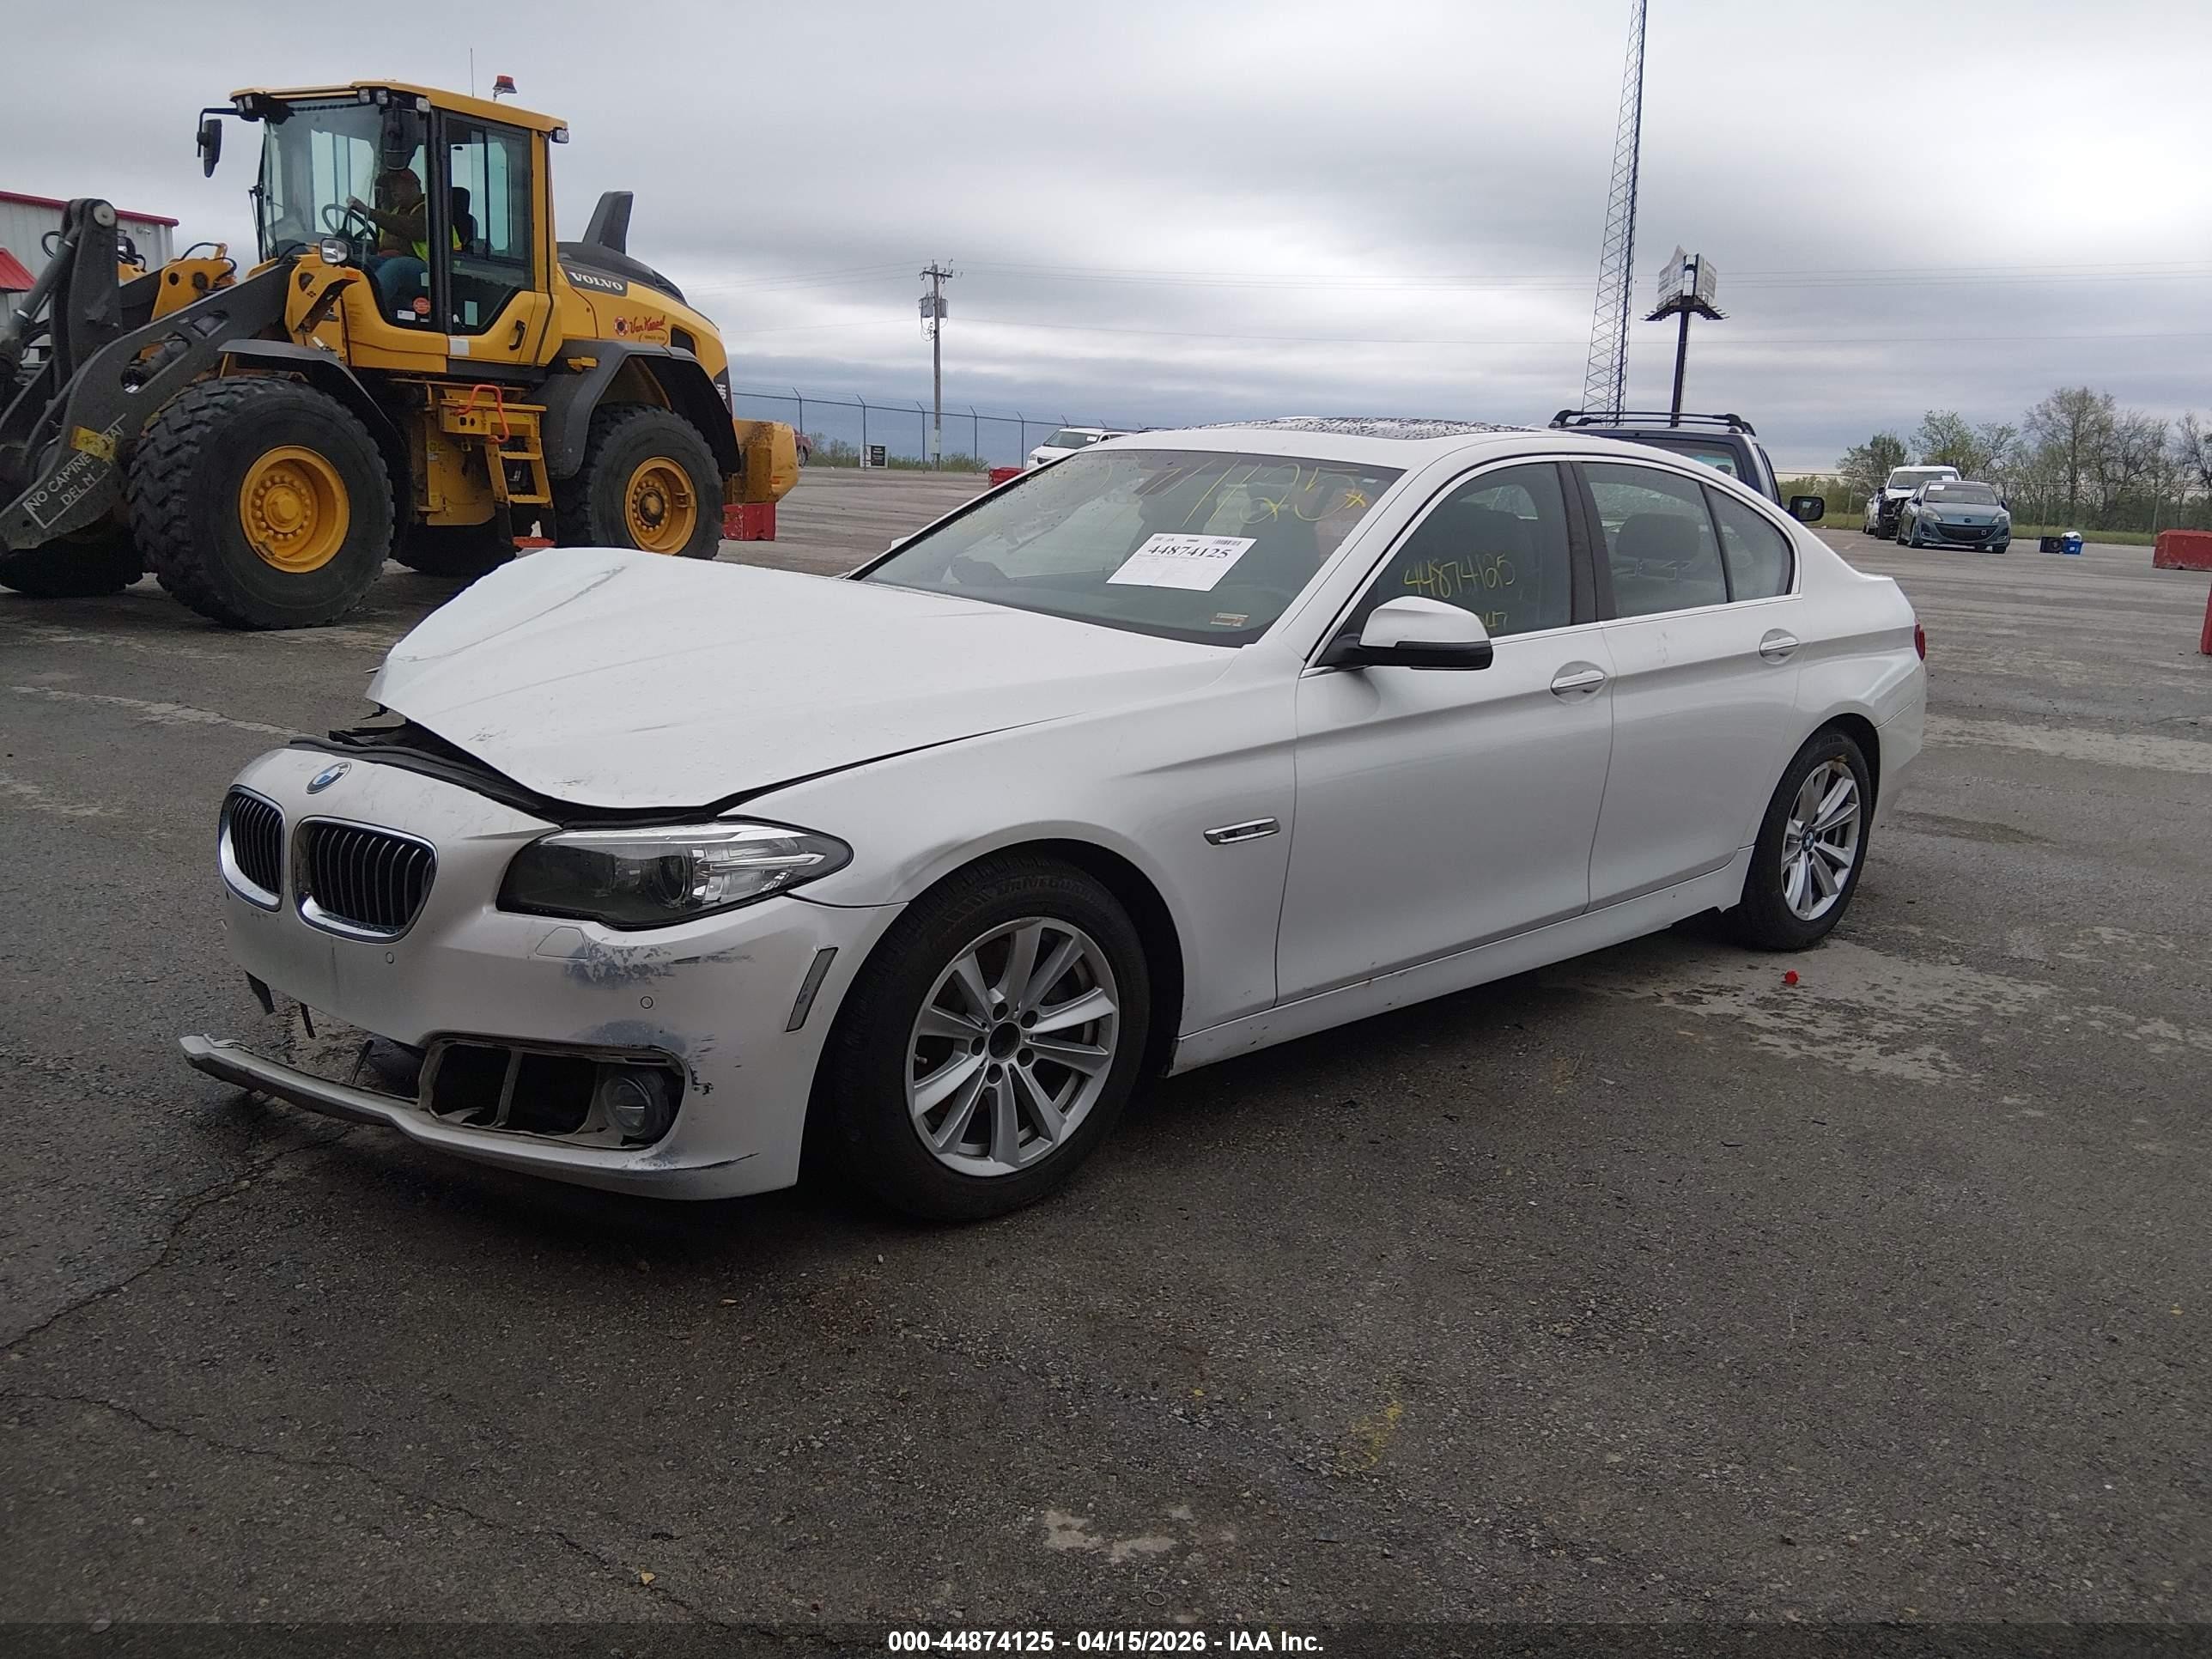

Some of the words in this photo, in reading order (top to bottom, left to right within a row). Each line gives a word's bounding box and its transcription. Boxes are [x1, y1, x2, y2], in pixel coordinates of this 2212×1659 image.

[569, 271, 623, 291] VOLVO
[26, 490, 48, 512] NO
[59, 484, 84, 506] DEL
[1148, 544, 1233, 559] 44874125
